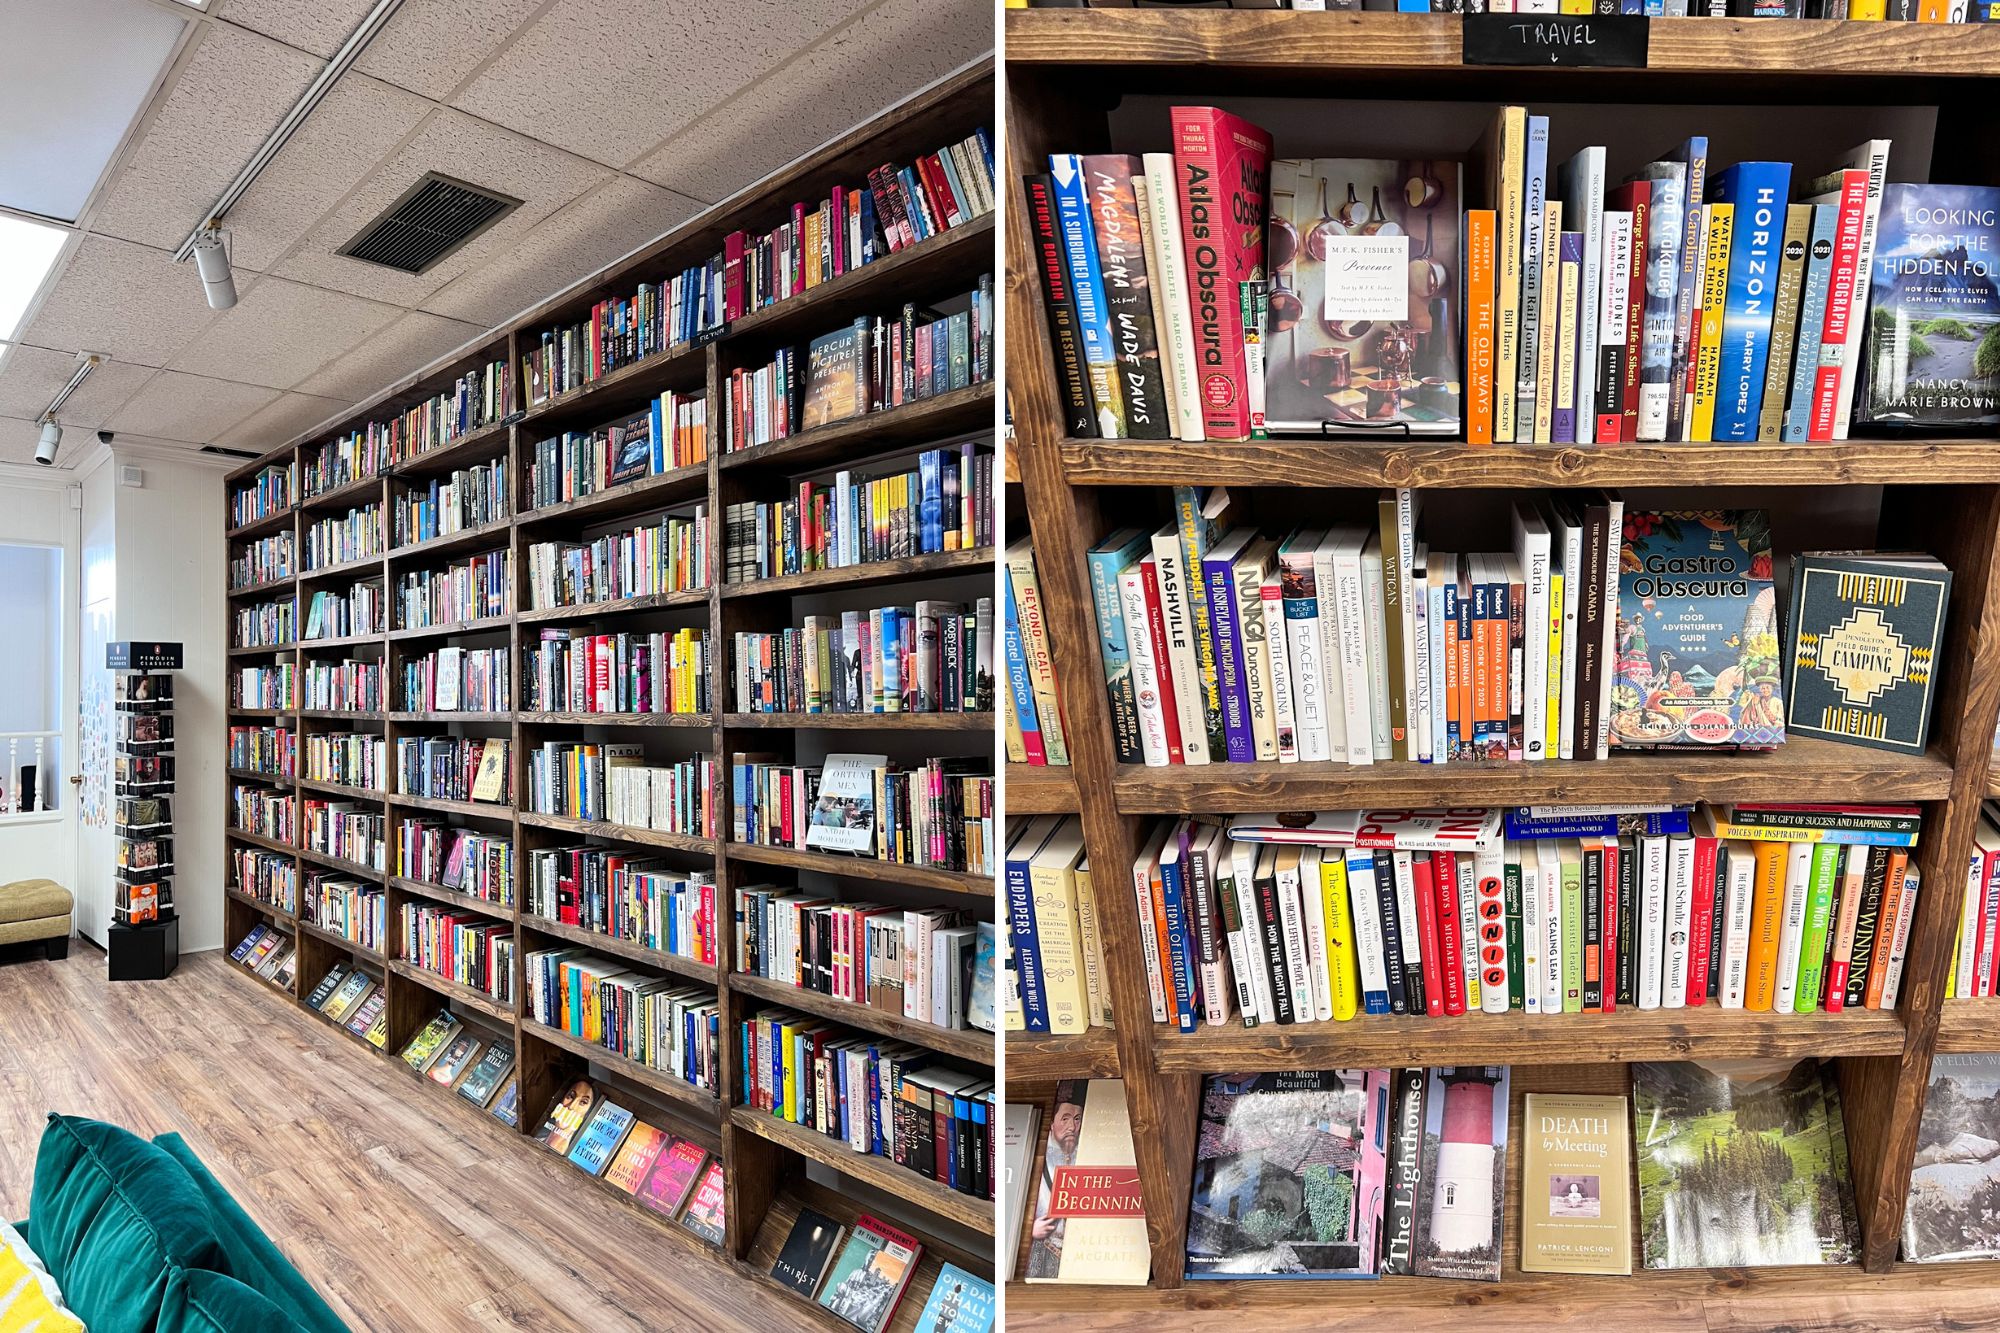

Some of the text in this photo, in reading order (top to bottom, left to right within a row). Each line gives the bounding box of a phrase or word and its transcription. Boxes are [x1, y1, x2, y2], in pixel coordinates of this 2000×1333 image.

[1508, 24, 1596, 46] TRAVEL
[1869, 154, 1884, 198] DAKOTAS
[1186, 164, 1213, 239] Atlas
[1685, 158, 1705, 274] South Carolina
[1905, 208, 1995, 226] LOOKING
[1031, 183, 1065, 300] ANTHONY BOURDAIN
[1094, 171, 1129, 289] MAGDALENA
[1547, 210, 1558, 269] STEINBECK
[1633, 203, 1646, 278] George Kennan
[1909, 234, 1988, 251] FOR THE
[1744, 188, 1774, 315] HORIZON
[1524, 176, 1543, 386] Great American Rail Journeys
[1612, 217, 1628, 337] STRANGE STONES
[1196, 245, 1222, 366] Obscura
[1802, 272, 1820, 326] TRAVEL
[1768, 272, 1792, 390] TRAVEL WRITING
[812, 348, 856, 370] PICTURES
[814, 362, 851, 380] PRESENTS
[1118, 313, 1150, 426] WADE DAVIS
[1476, 302, 1489, 414] THE OLD WAYS
[1696, 347, 1708, 405] KIRSHNER
[1706, 347, 1718, 396] HANNAH
[1737, 331, 1755, 414] BARRY LOPEZ
[1794, 330, 1811, 390] WRITING
[816, 380, 844, 394] ANTHONY
[1818, 373, 1836, 432] TIM MARSHALL
[1885, 396, 1994, 408] MARIE BROWN
[1915, 378, 1968, 390] NANCY
[1400, 492, 1411, 569] Outer Banks
[1531, 553, 1546, 595] Ikaria
[1567, 538, 1579, 600] CHESAPEAKE
[1606, 518, 1621, 602] SWITZERLAND
[1646, 554, 1736, 575] Gastro
[1093, 561, 1113, 639] OFFERMAN
[1108, 584, 1122, 618] NICK
[1386, 557, 1397, 606] VATICAN
[1633, 577, 1748, 598] Obscura
[1161, 558, 1185, 648] NASHVILLE
[948, 618, 957, 668] MOBY-DICK
[1024, 588, 1042, 638] BEYOND
[1037, 651, 1051, 682] CALL
[1212, 572, 1242, 729] THE DISNEYLAND ENCYCLOPEDIA STRODDER
[1846, 634, 1884, 644] PENDLETON
[1004, 630, 1028, 706] Hotel Trópico
[1246, 647, 1260, 692] Duncan
[1269, 621, 1287, 715] SOUTH CAROLINA
[1448, 647, 1457, 688] ORLEANS
[1833, 650, 1892, 673] CAMPING
[1251, 692, 1264, 720] Pryde
[1599, 716, 1608, 750] TIGER
[842, 760, 862, 768] THE
[838, 782, 856, 790] MEN
[1356, 838, 1394, 847] POSITIONING
[1728, 828, 1808, 838] VOICES OF INSPIRATION
[1329, 871, 1342, 928] The Catalyst
[1441, 883, 1450, 909] BOYS
[1648, 846, 1660, 924] HOW TO LEAD
[1674, 848, 1690, 926] Howard Schultz
[1812, 848, 1837, 928] Mavericks Work
[1009, 871, 1039, 1012] ENDPAPERS ALEXANDER WOLFF
[1082, 902, 1099, 996] POWER LIBERTY
[1311, 926, 1322, 961] REMOTE
[1444, 924, 1458, 999] MICHAEL LEWIS
[1548, 916, 1558, 981] SCALING LEAN
[1696, 908, 1711, 984] TREASURE HUNT
[1848, 912, 1876, 991] WINNING
[1267, 925, 1290, 1018] HOW THE MIGHTY FALL
[1671, 951, 1684, 990] Onward
[486, 1055, 502, 1068] HILL
[488, 1046, 510, 1062] SUSAN
[1296, 1070, 1320, 1079] Most
[1276, 1079, 1320, 1088] Beautiful
[1541, 1116, 1608, 1136] DEATH
[575, 1146, 602, 1166] LYNCH
[622, 1150, 646, 1170] GIRL
[626, 1140, 655, 1159] DREAM
[676, 1142, 704, 1158] RUTHIE
[676, 1152, 696, 1164] FEAR
[1543, 1138, 1608, 1158] by Meeting
[610, 1169, 638, 1188] LIPPMAN
[617, 1163, 638, 1179] LAURA
[1060, 1172, 1112, 1188] IN THE
[1388, 1078, 1422, 1268] The Lighthouse
[1056, 1190, 1142, 1210] BEGINNIN
[684, 1218, 719, 1240] TOM LIN
[866, 1232, 880, 1244] TIME
[777, 1260, 816, 1286] THIRST
[943, 1274, 994, 1304] ONE DAY
[926, 1311, 944, 1324] THE
[931, 1301, 982, 1331] ASTONISH
[937, 1286, 986, 1320] I SHALL
